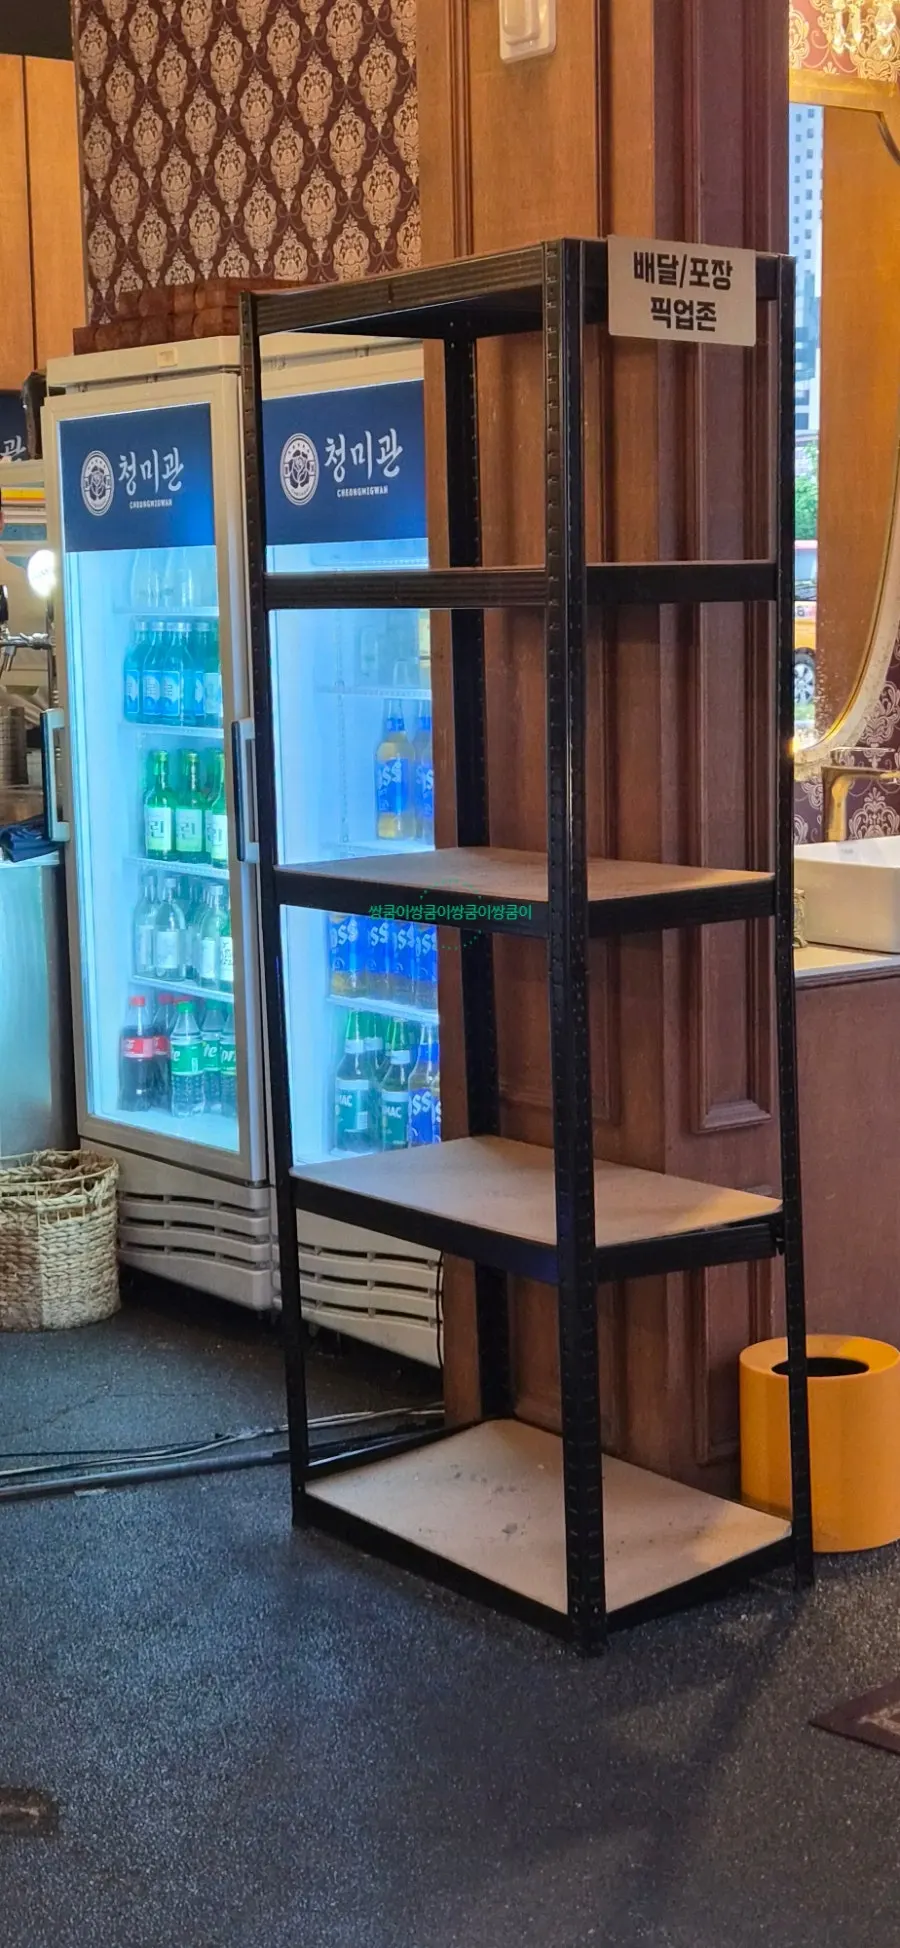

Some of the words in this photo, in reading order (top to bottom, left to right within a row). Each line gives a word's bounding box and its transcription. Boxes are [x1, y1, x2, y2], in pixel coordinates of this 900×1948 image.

[633, 251, 733, 291] 배달/포장
[651, 297, 717, 332] 픽업존
[118, 447, 184, 496] 청미관
[324, 428, 403, 482] 청미관
